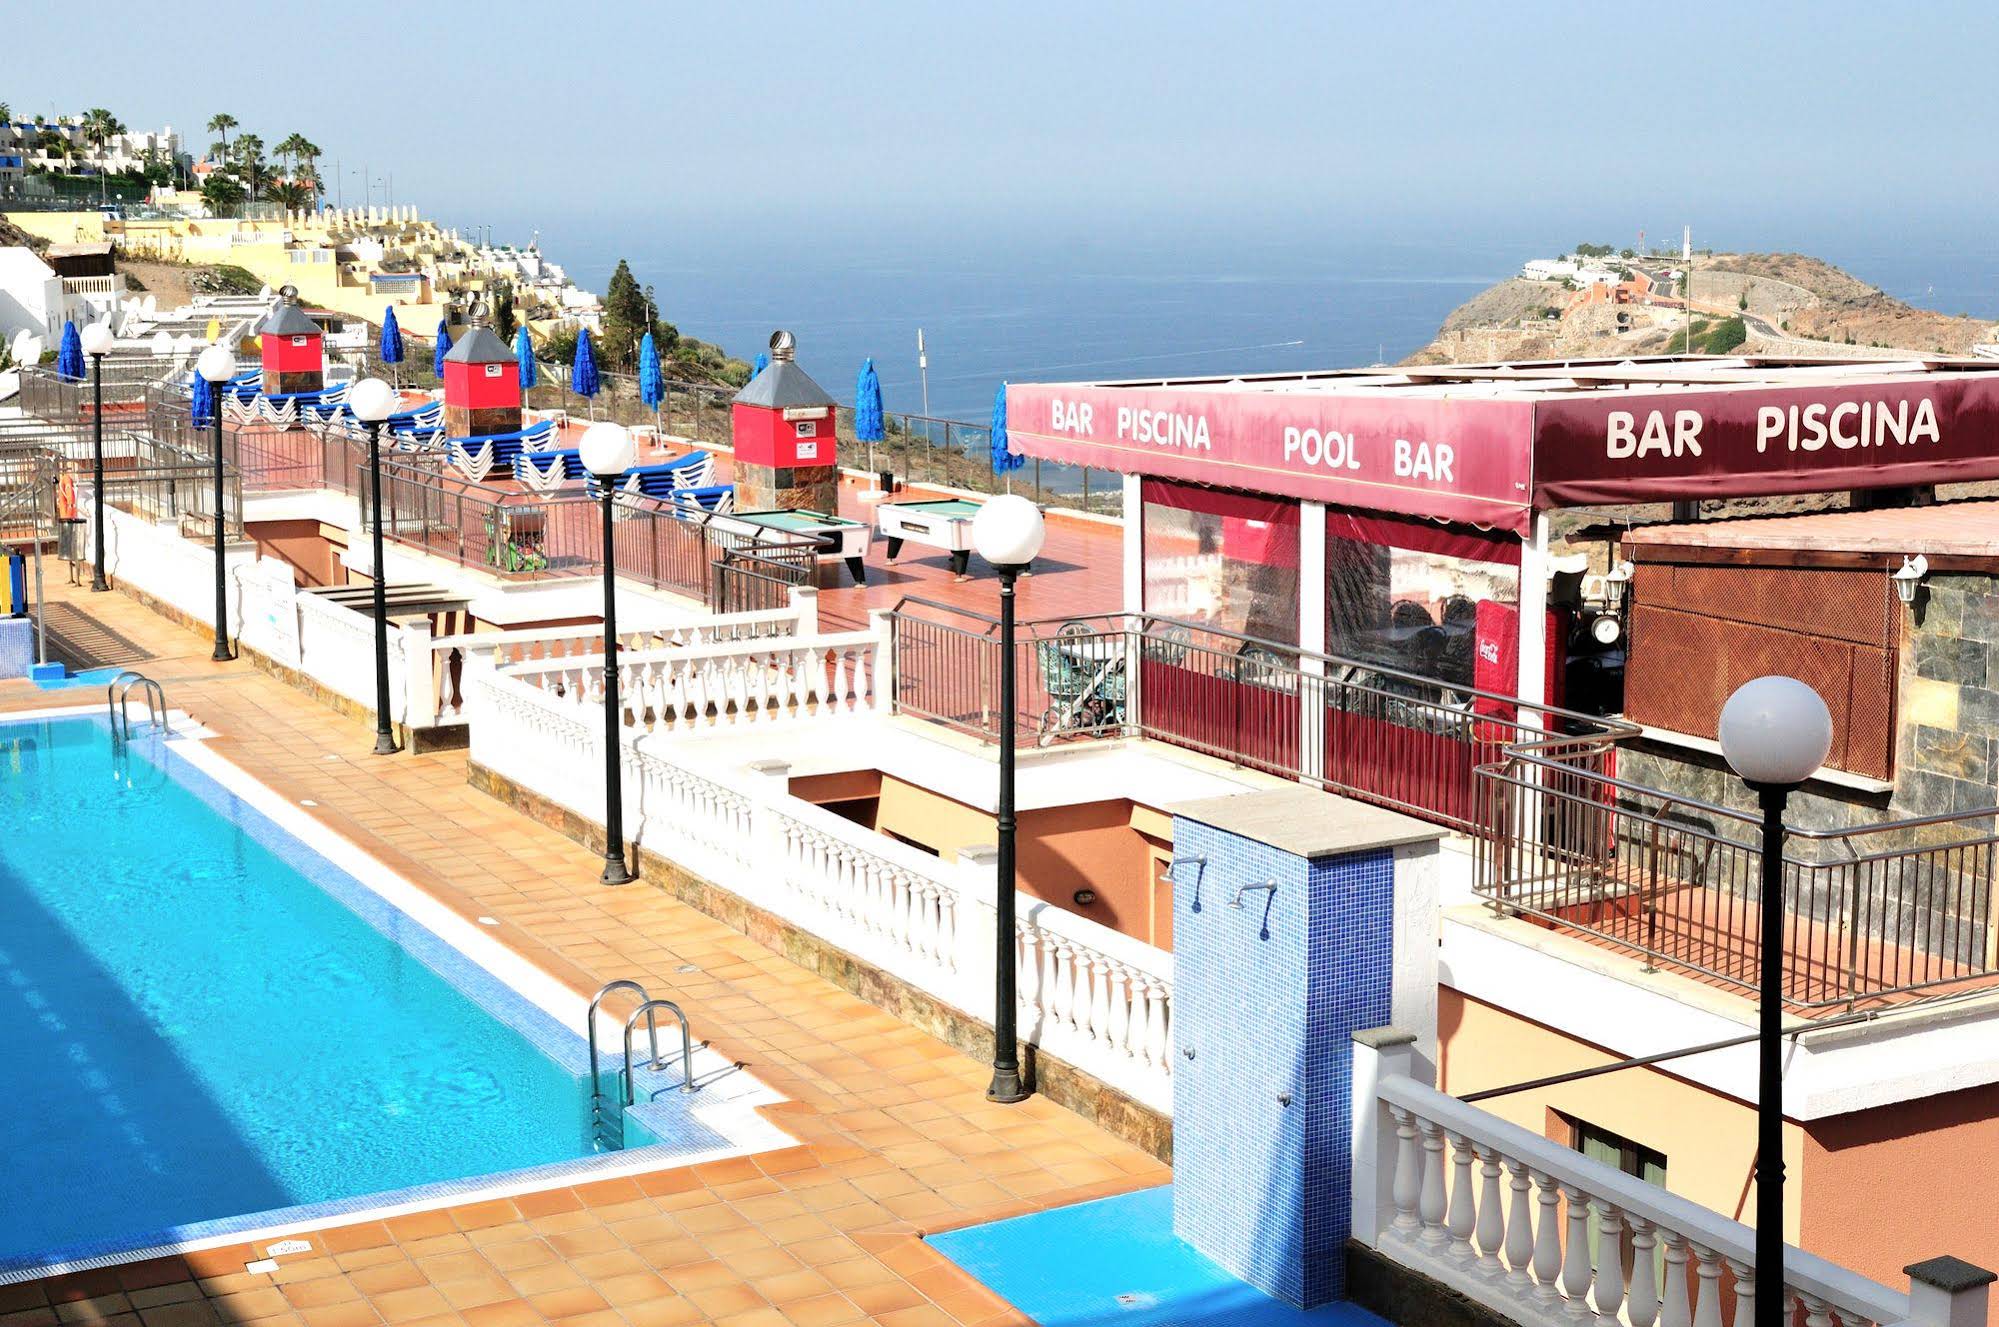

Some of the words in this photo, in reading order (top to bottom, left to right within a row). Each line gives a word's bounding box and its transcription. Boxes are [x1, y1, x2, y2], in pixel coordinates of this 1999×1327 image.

[1051, 399, 1094, 436] BAR
[1117, 407, 1212, 450] PISCINA
[1606, 409, 1704, 459] BAR
[1756, 397, 1940, 453] PISCINA
[1284, 426, 1361, 469] POOL
[1393, 439, 1455, 483] BAR
